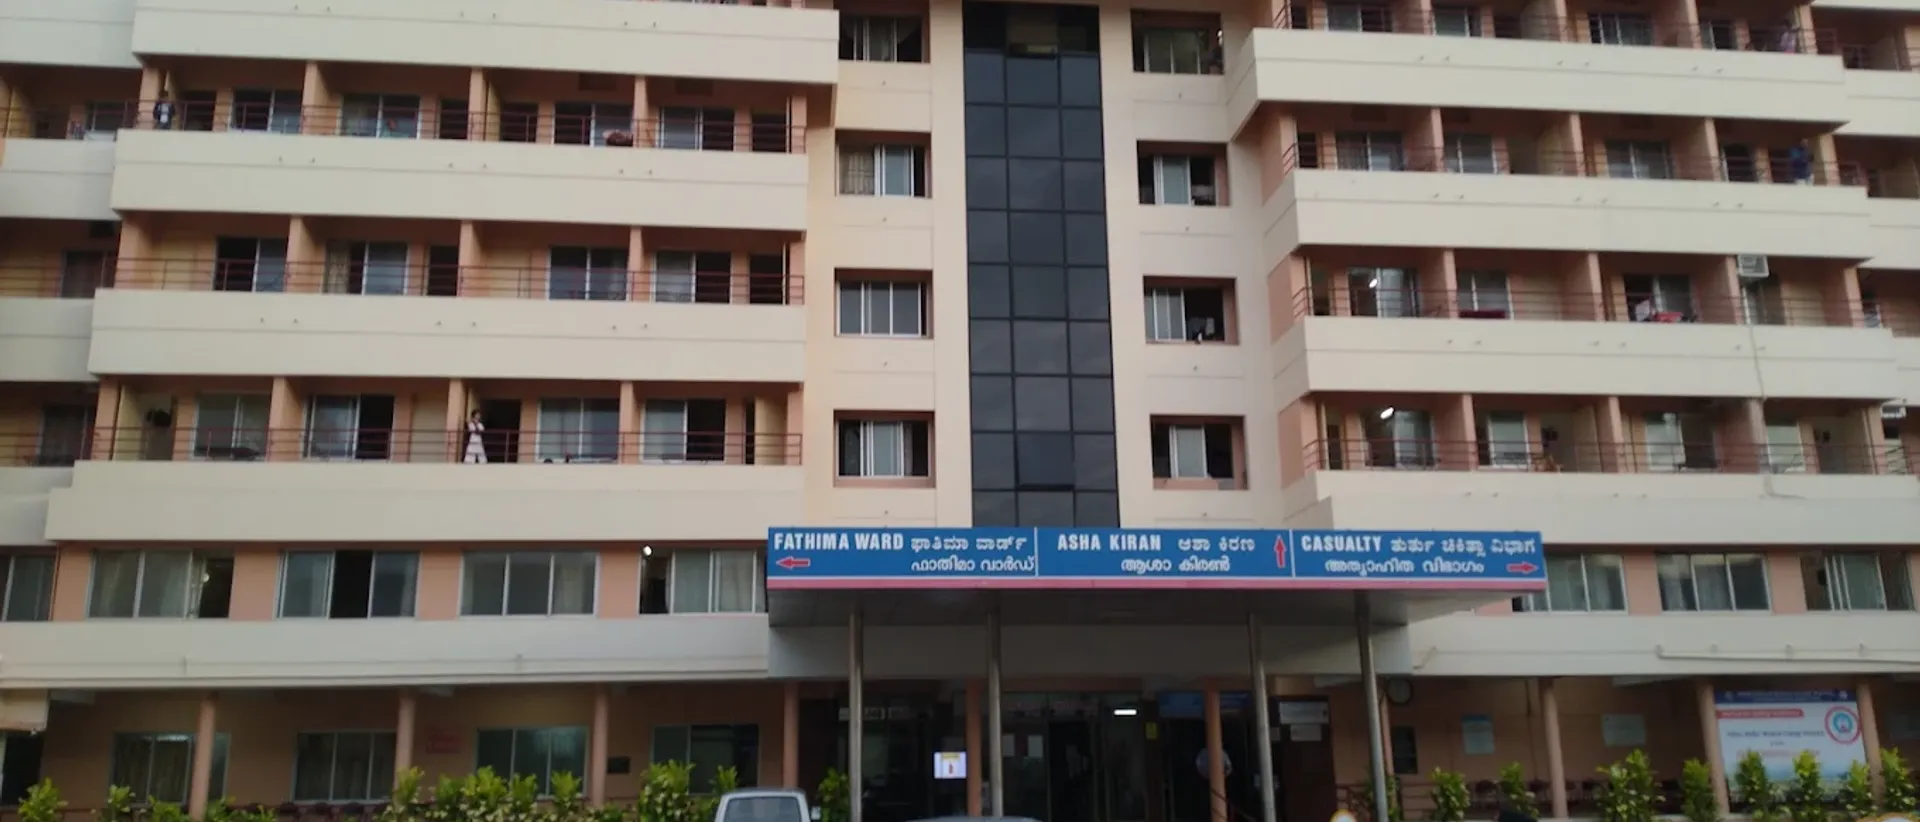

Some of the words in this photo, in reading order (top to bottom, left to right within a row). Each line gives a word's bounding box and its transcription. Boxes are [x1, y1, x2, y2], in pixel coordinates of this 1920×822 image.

[774, 532, 850, 550] FATHIMA
[854, 532, 904, 550] WARD
[1057, 533, 1101, 551] ASHA
[1109, 533, 1161, 551] KIRAN
[1178, 537, 1210, 551] ಆಶಾ
[1218, 536, 1256, 552] ಕಿರಣ
[1301, 535, 1382, 552] CASUALTY
[1491, 538, 1536, 556] ವಿಭಾಗ
[911, 554, 976, 571] ഫാതിമാ
[1121, 558, 1173, 575] ആശാ
[1325, 557, 1415, 577] അത്യാഹിത
[1422, 556, 1485, 573] വിഭാഗം
